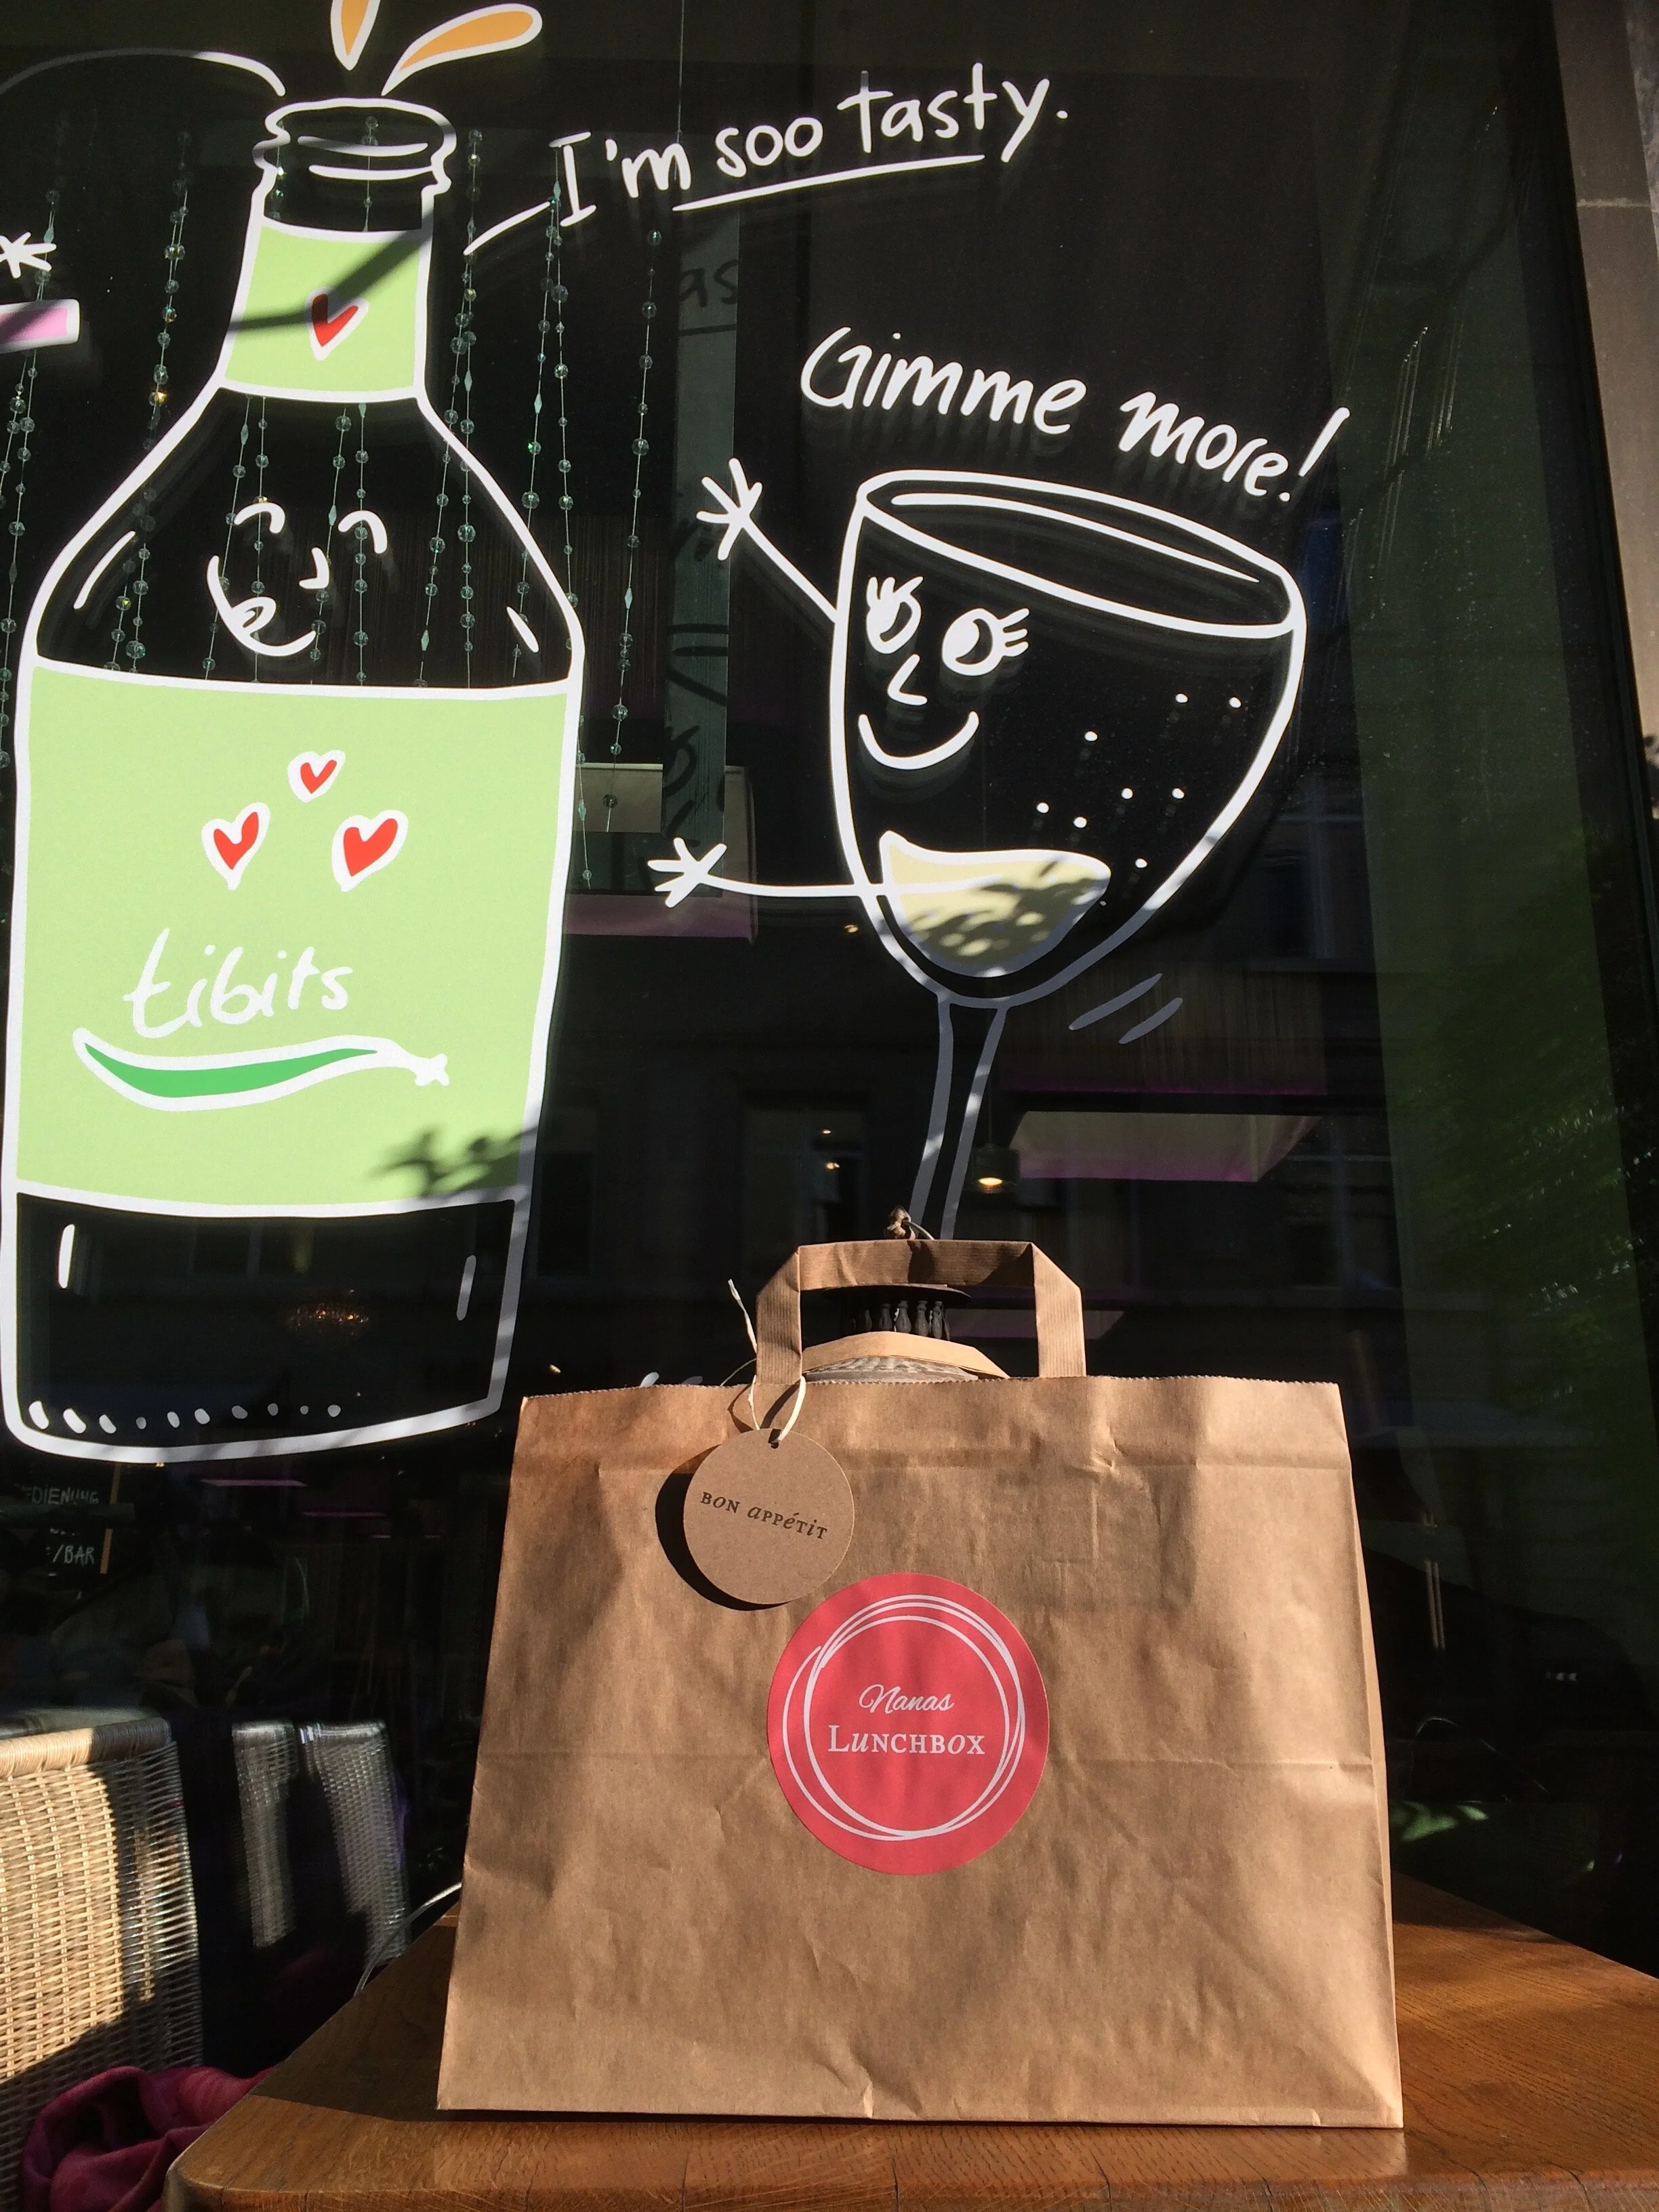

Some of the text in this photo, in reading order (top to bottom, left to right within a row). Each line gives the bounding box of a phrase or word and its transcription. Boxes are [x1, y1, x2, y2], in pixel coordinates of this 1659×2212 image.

[550, 62, 1069, 228] I'm soo tasty.
[800, 326, 1351, 503] Gimme more!
[122, 926, 354, 1039] tibits
[699, 1491, 741, 1514] BON
[858, 1683, 955, 1715] Nanas
